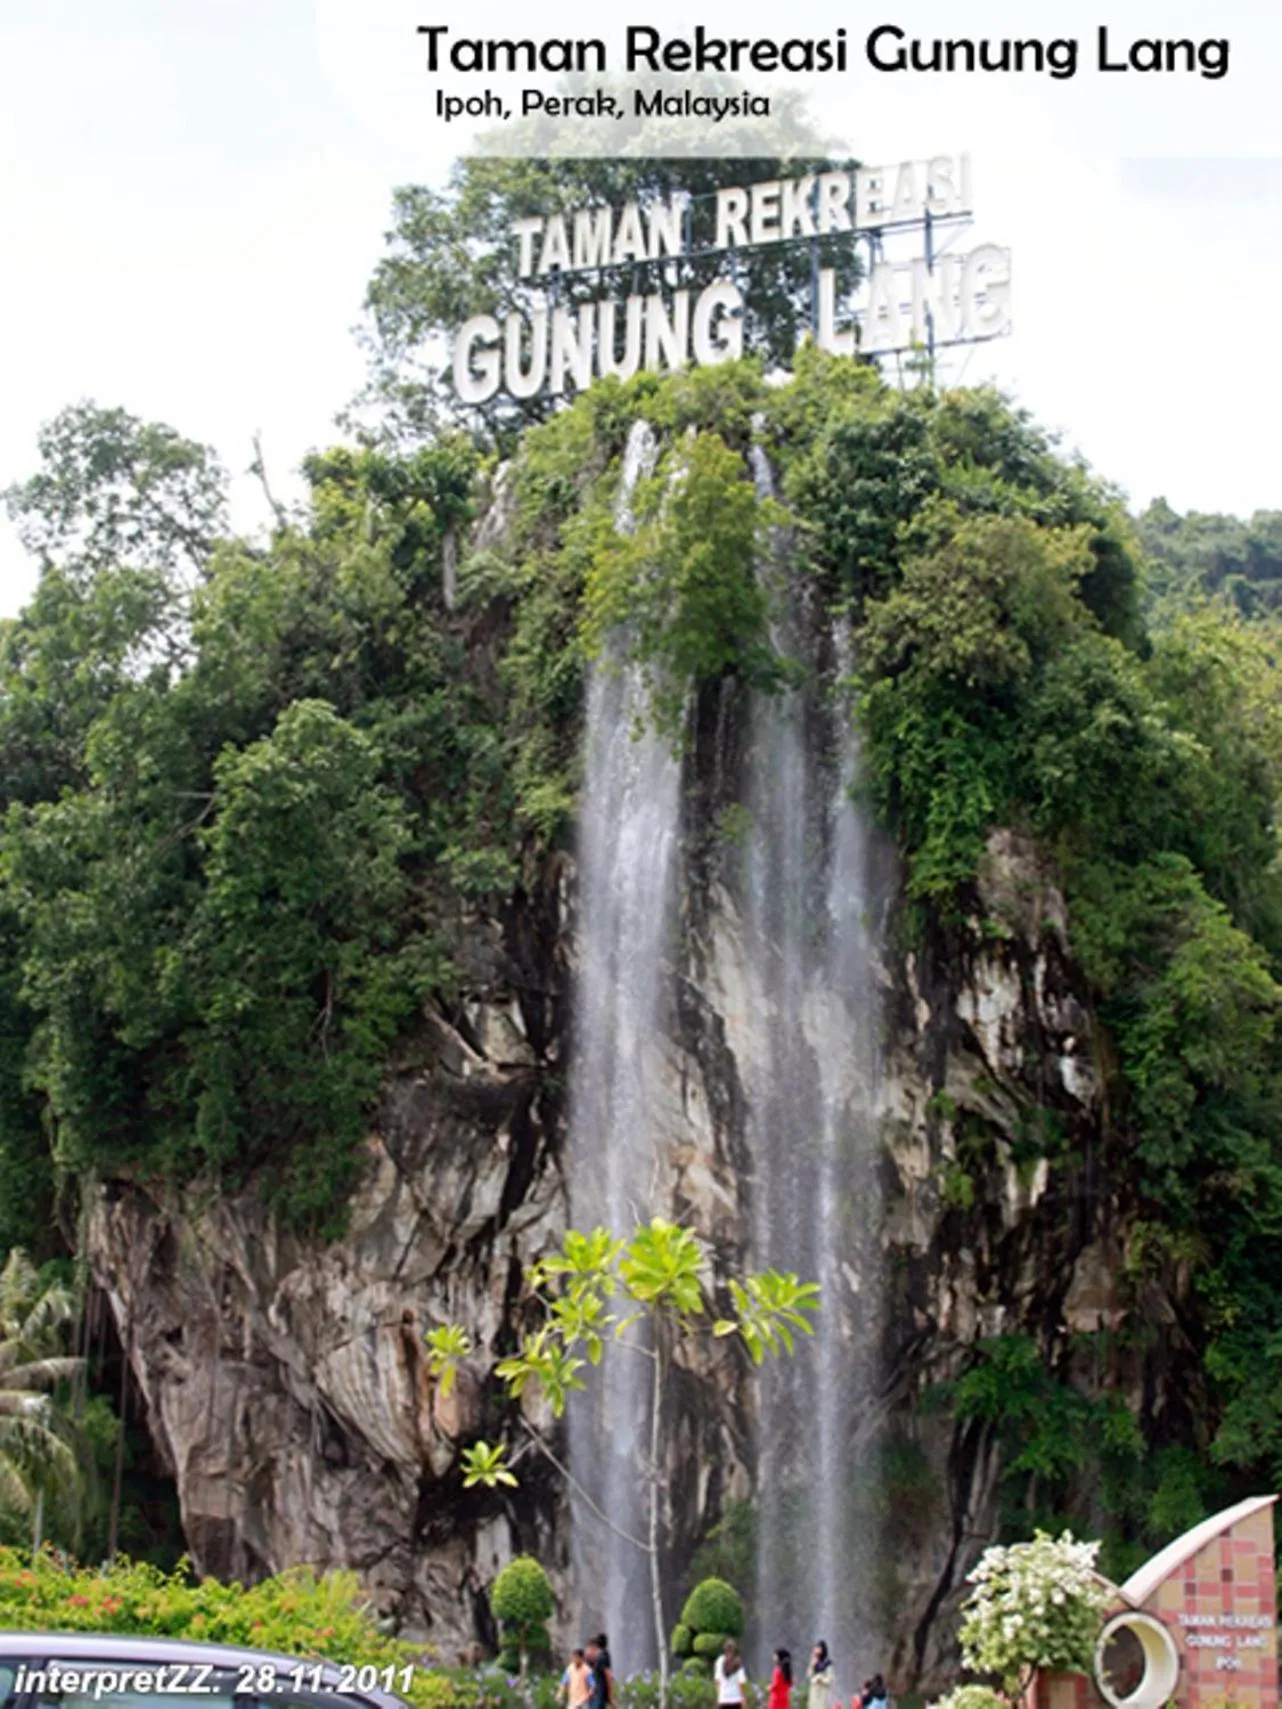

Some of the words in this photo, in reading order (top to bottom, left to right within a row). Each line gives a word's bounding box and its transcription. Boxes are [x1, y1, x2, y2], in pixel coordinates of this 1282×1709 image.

[511, 194, 686, 278] TAMAN
[714, 153, 973, 250] REKREASI
[453, 280, 744, 404] GUNUNG
[817, 243, 1012, 357] LANG
